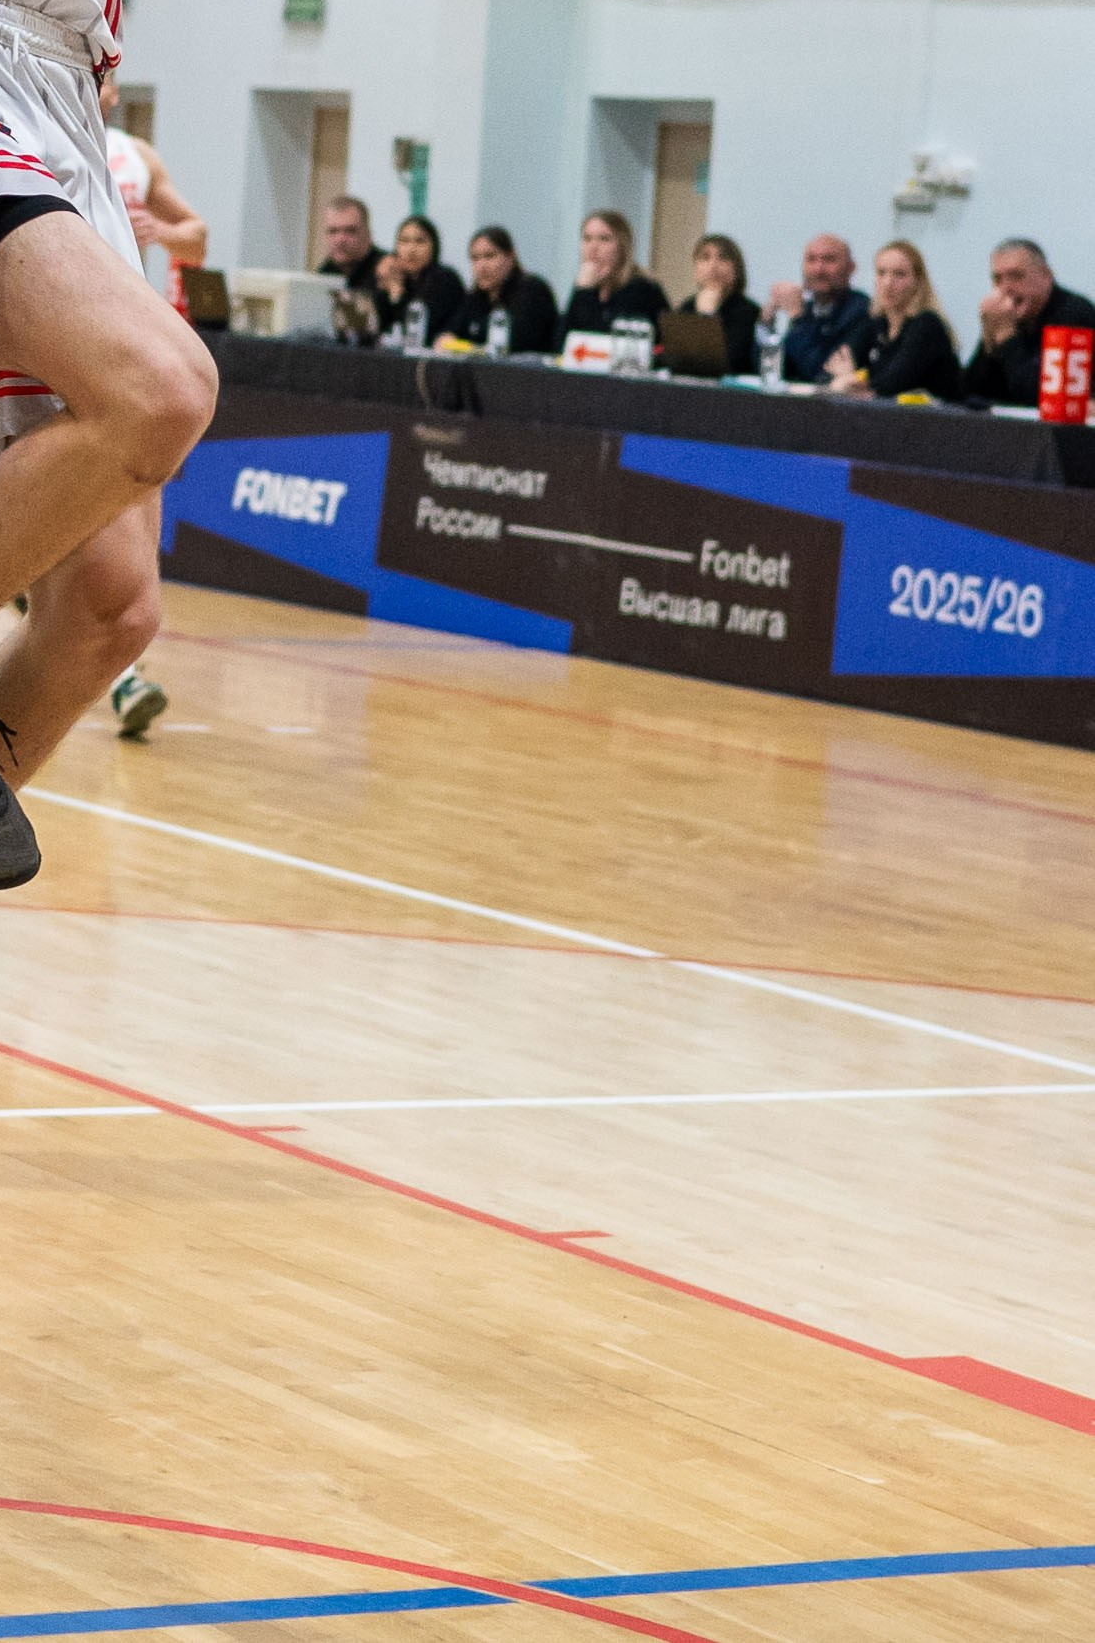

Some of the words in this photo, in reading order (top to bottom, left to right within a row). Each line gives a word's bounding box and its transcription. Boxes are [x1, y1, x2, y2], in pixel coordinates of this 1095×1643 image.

[232, 467, 347, 526] FONBET
[424, 451, 548, 499] Чемпионат
[416, 495, 502, 541] России
[700, 539, 790, 589] Fonbet
[619, 577, 720, 629] Высшая
[725, 604, 788, 641] лига
[889, 564, 1044, 638] 2025/26
